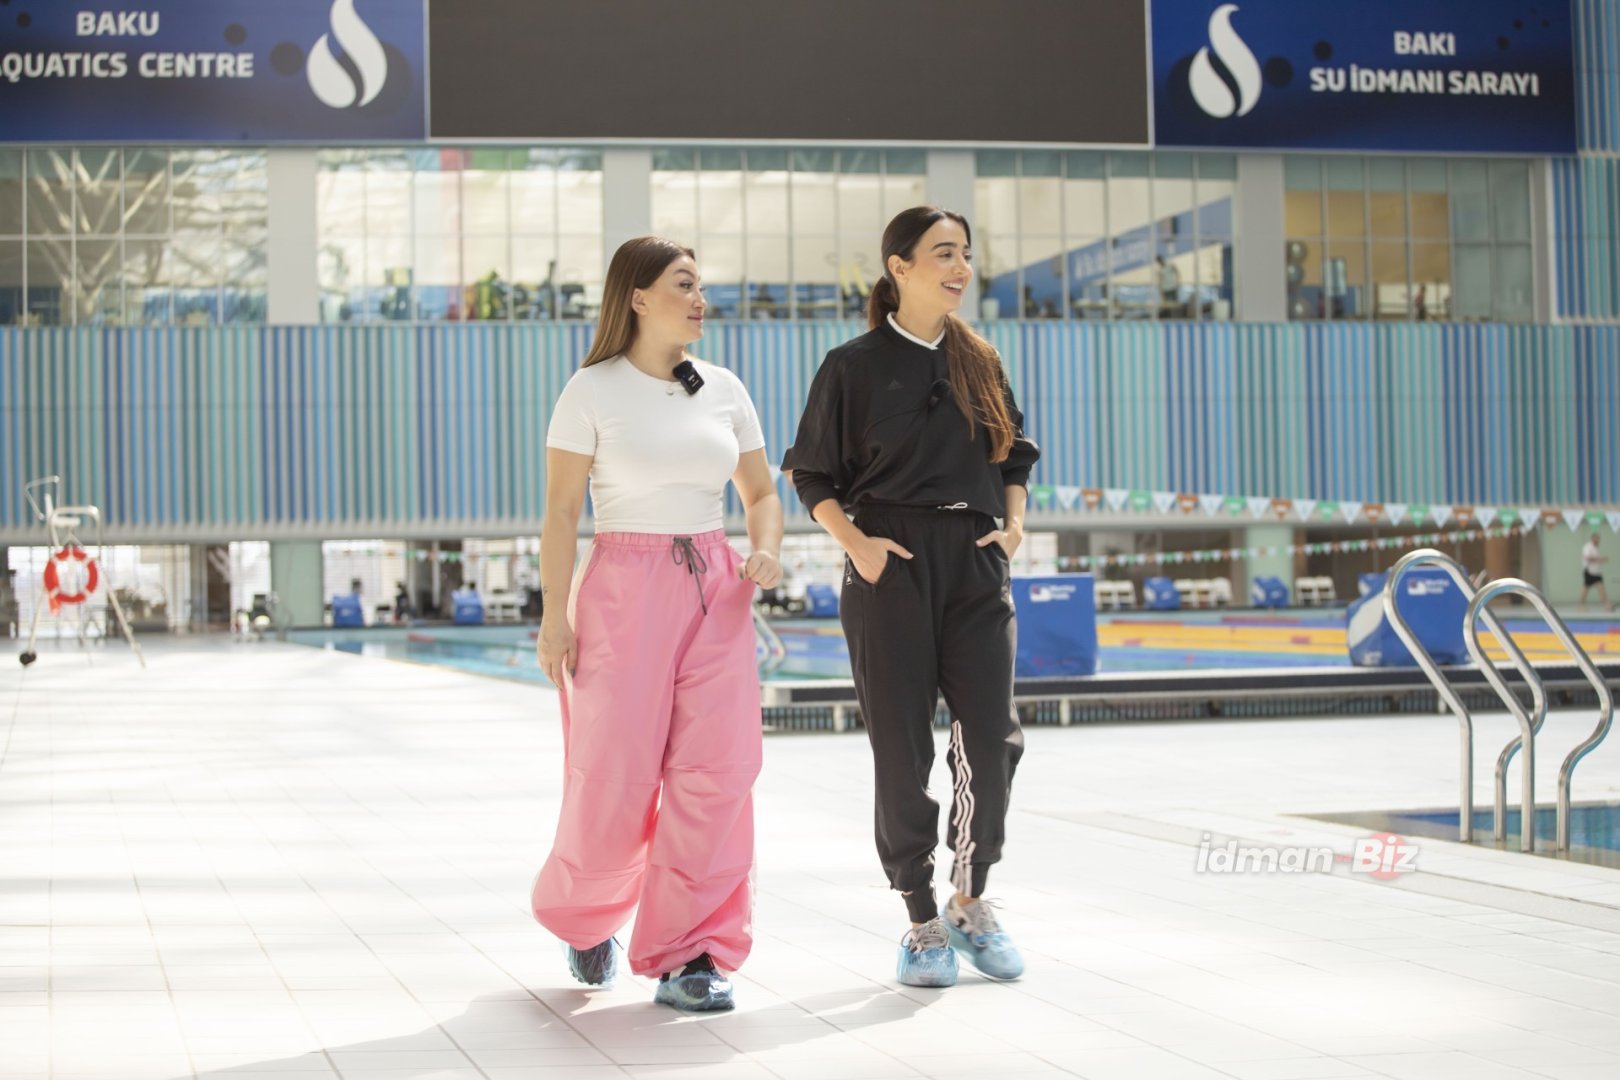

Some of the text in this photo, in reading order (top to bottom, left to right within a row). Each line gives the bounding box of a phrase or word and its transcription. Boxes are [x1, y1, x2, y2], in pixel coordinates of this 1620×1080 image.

[76, 11, 160, 36] BAKU
[1393, 31, 1456, 56] BAKI
[0, 52, 254, 83] QUATICS CENTRE
[1309, 63, 1539, 96] SU İDMANI SARAYI
